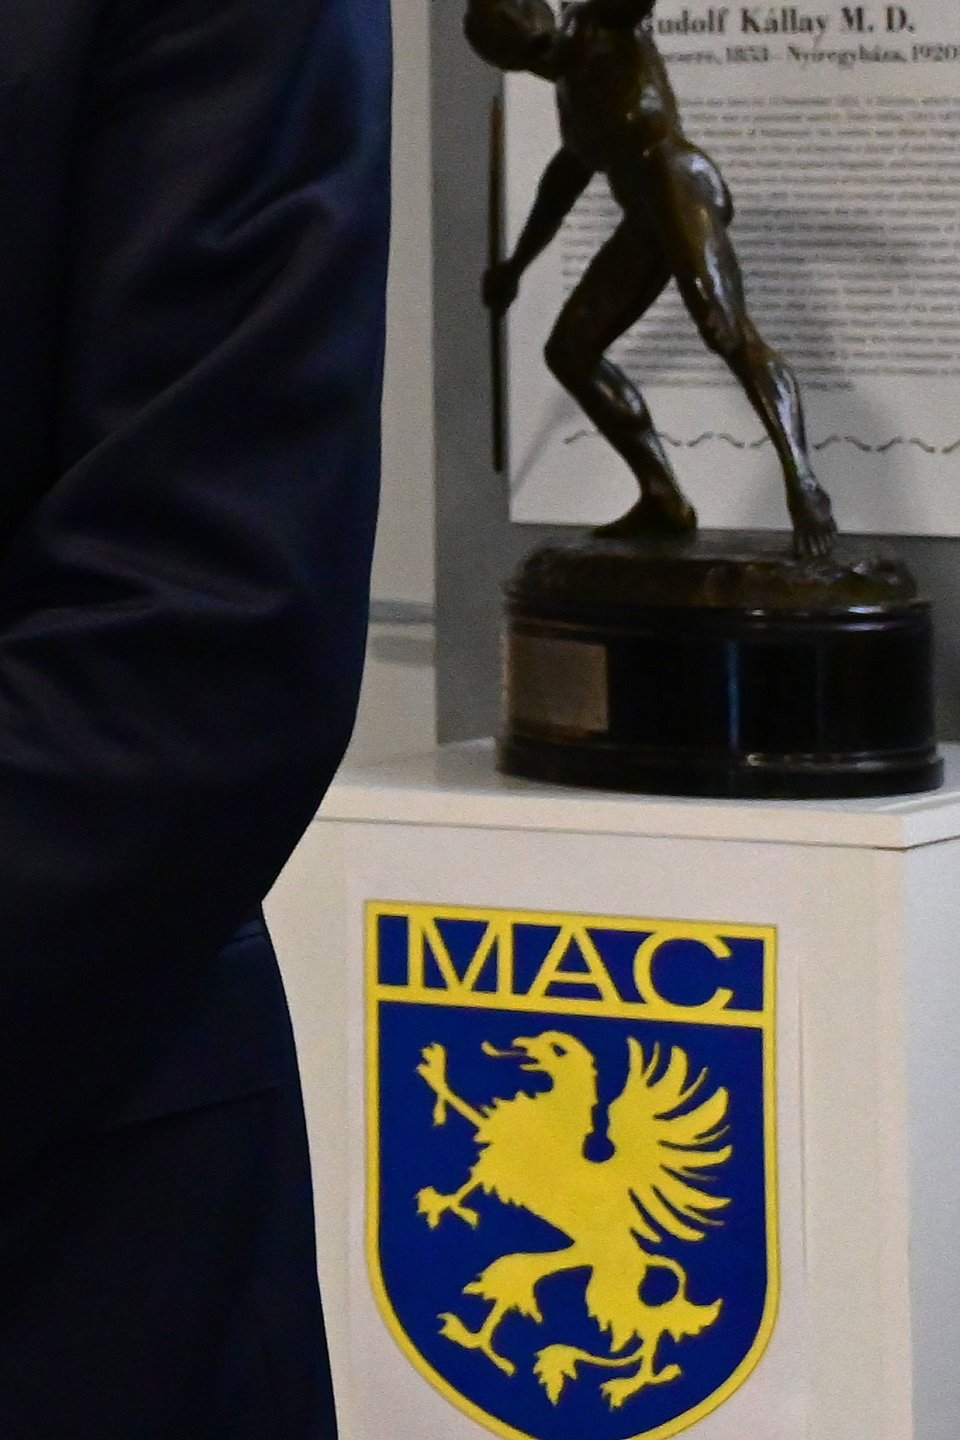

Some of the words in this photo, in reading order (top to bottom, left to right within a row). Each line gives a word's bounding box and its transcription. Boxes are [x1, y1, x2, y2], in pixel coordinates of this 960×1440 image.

[657, 7, 729, 33] udolf
[740, 7, 827, 47] Kállay
[841, 6, 874, 32] M.
[886, 6, 916, 32] D.
[407, 916, 734, 1010] MAC
